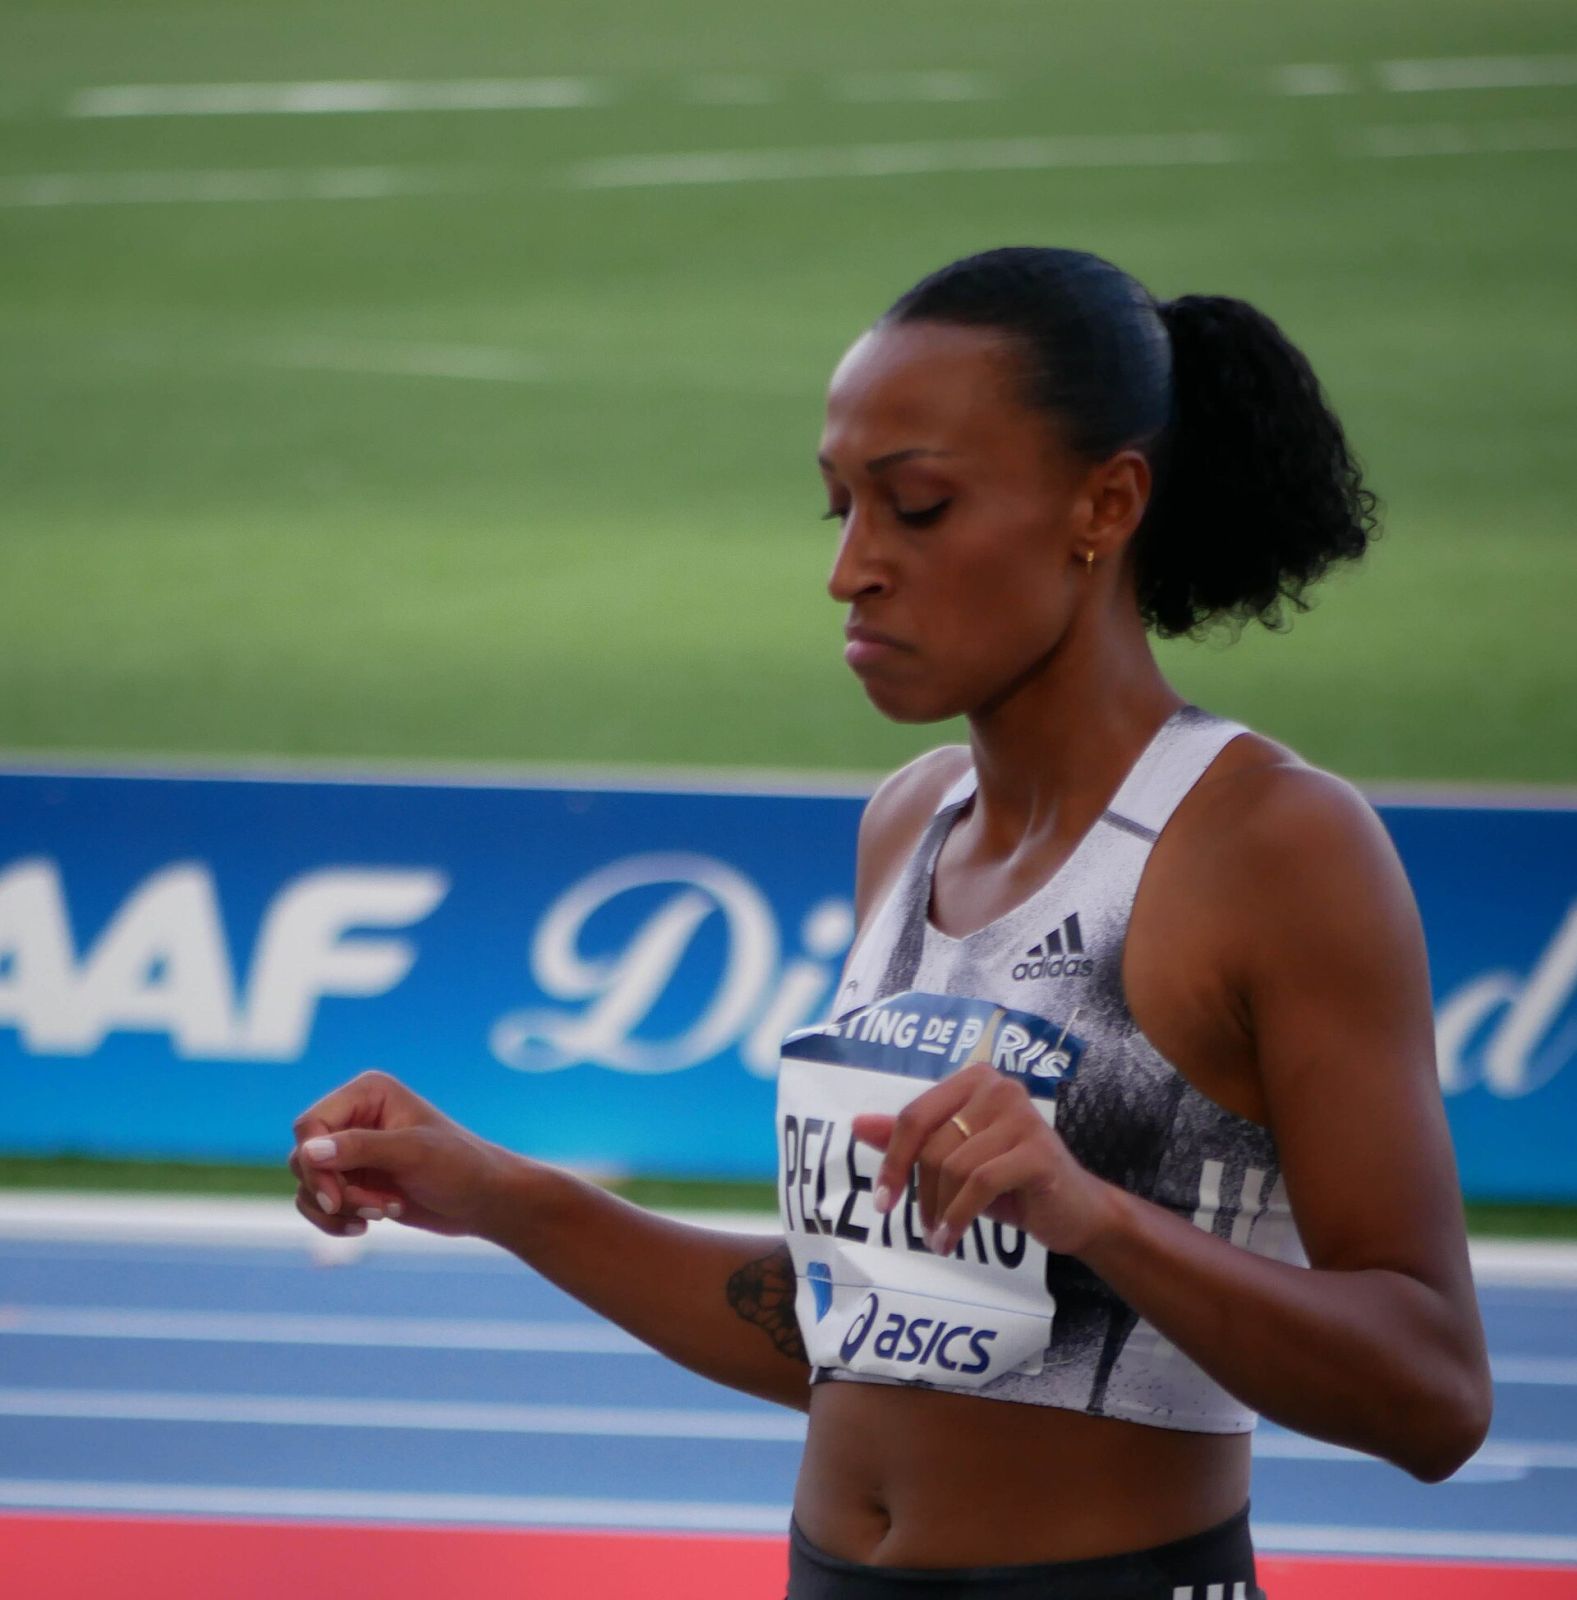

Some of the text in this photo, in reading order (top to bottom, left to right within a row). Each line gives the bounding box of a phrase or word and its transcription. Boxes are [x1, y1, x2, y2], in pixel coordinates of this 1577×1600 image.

[1012, 954, 1093, 980] adidas
[815, 1009, 1072, 1078] TING DE PRIS
